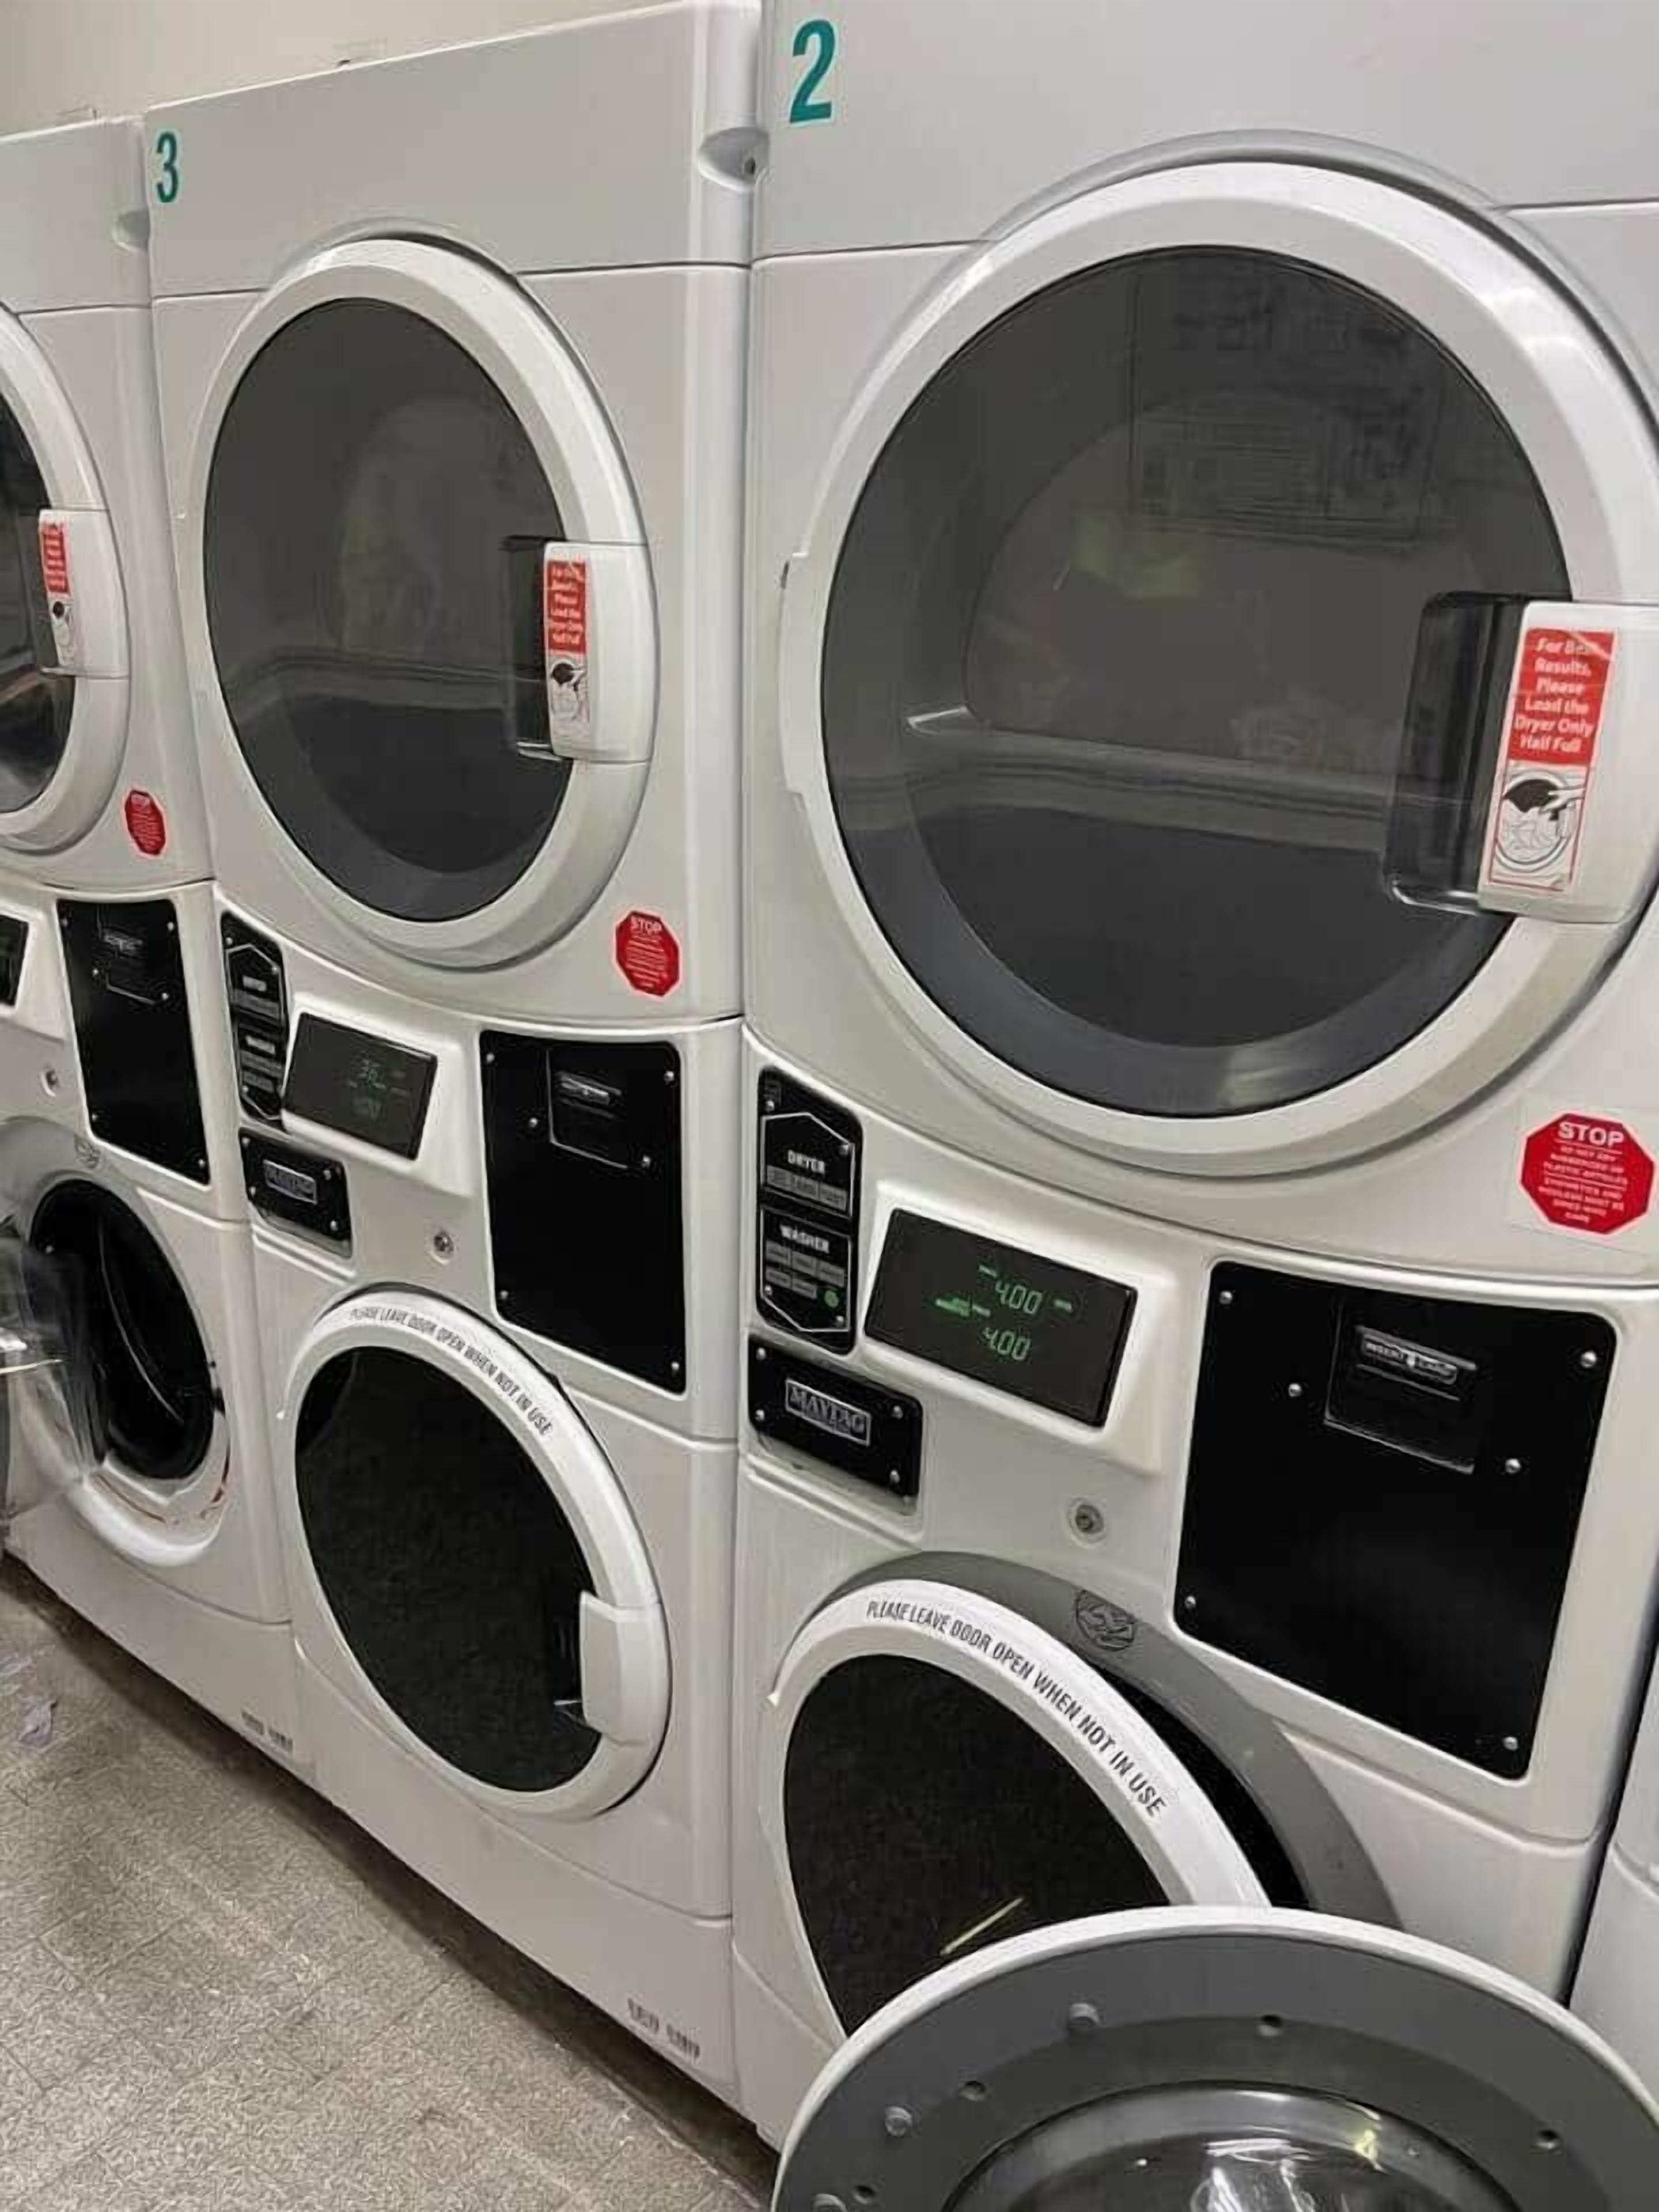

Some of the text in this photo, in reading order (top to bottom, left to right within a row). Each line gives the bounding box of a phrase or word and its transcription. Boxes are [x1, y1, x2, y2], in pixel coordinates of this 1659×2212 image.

[790, 20, 837, 123] 2
[156, 132, 180, 203] 3
[1516, 713, 1594, 737] Dryer Only
[1558, 1122, 1624, 1147] STOP
[993, 1641, 1035, 1680] OPEN
[1033, 1672, 1082, 1721] WHEN
[1076, 1714, 1116, 1752] NOT
[1109, 1750, 1134, 1775] IN
[1128, 1774, 1166, 1817] USE
